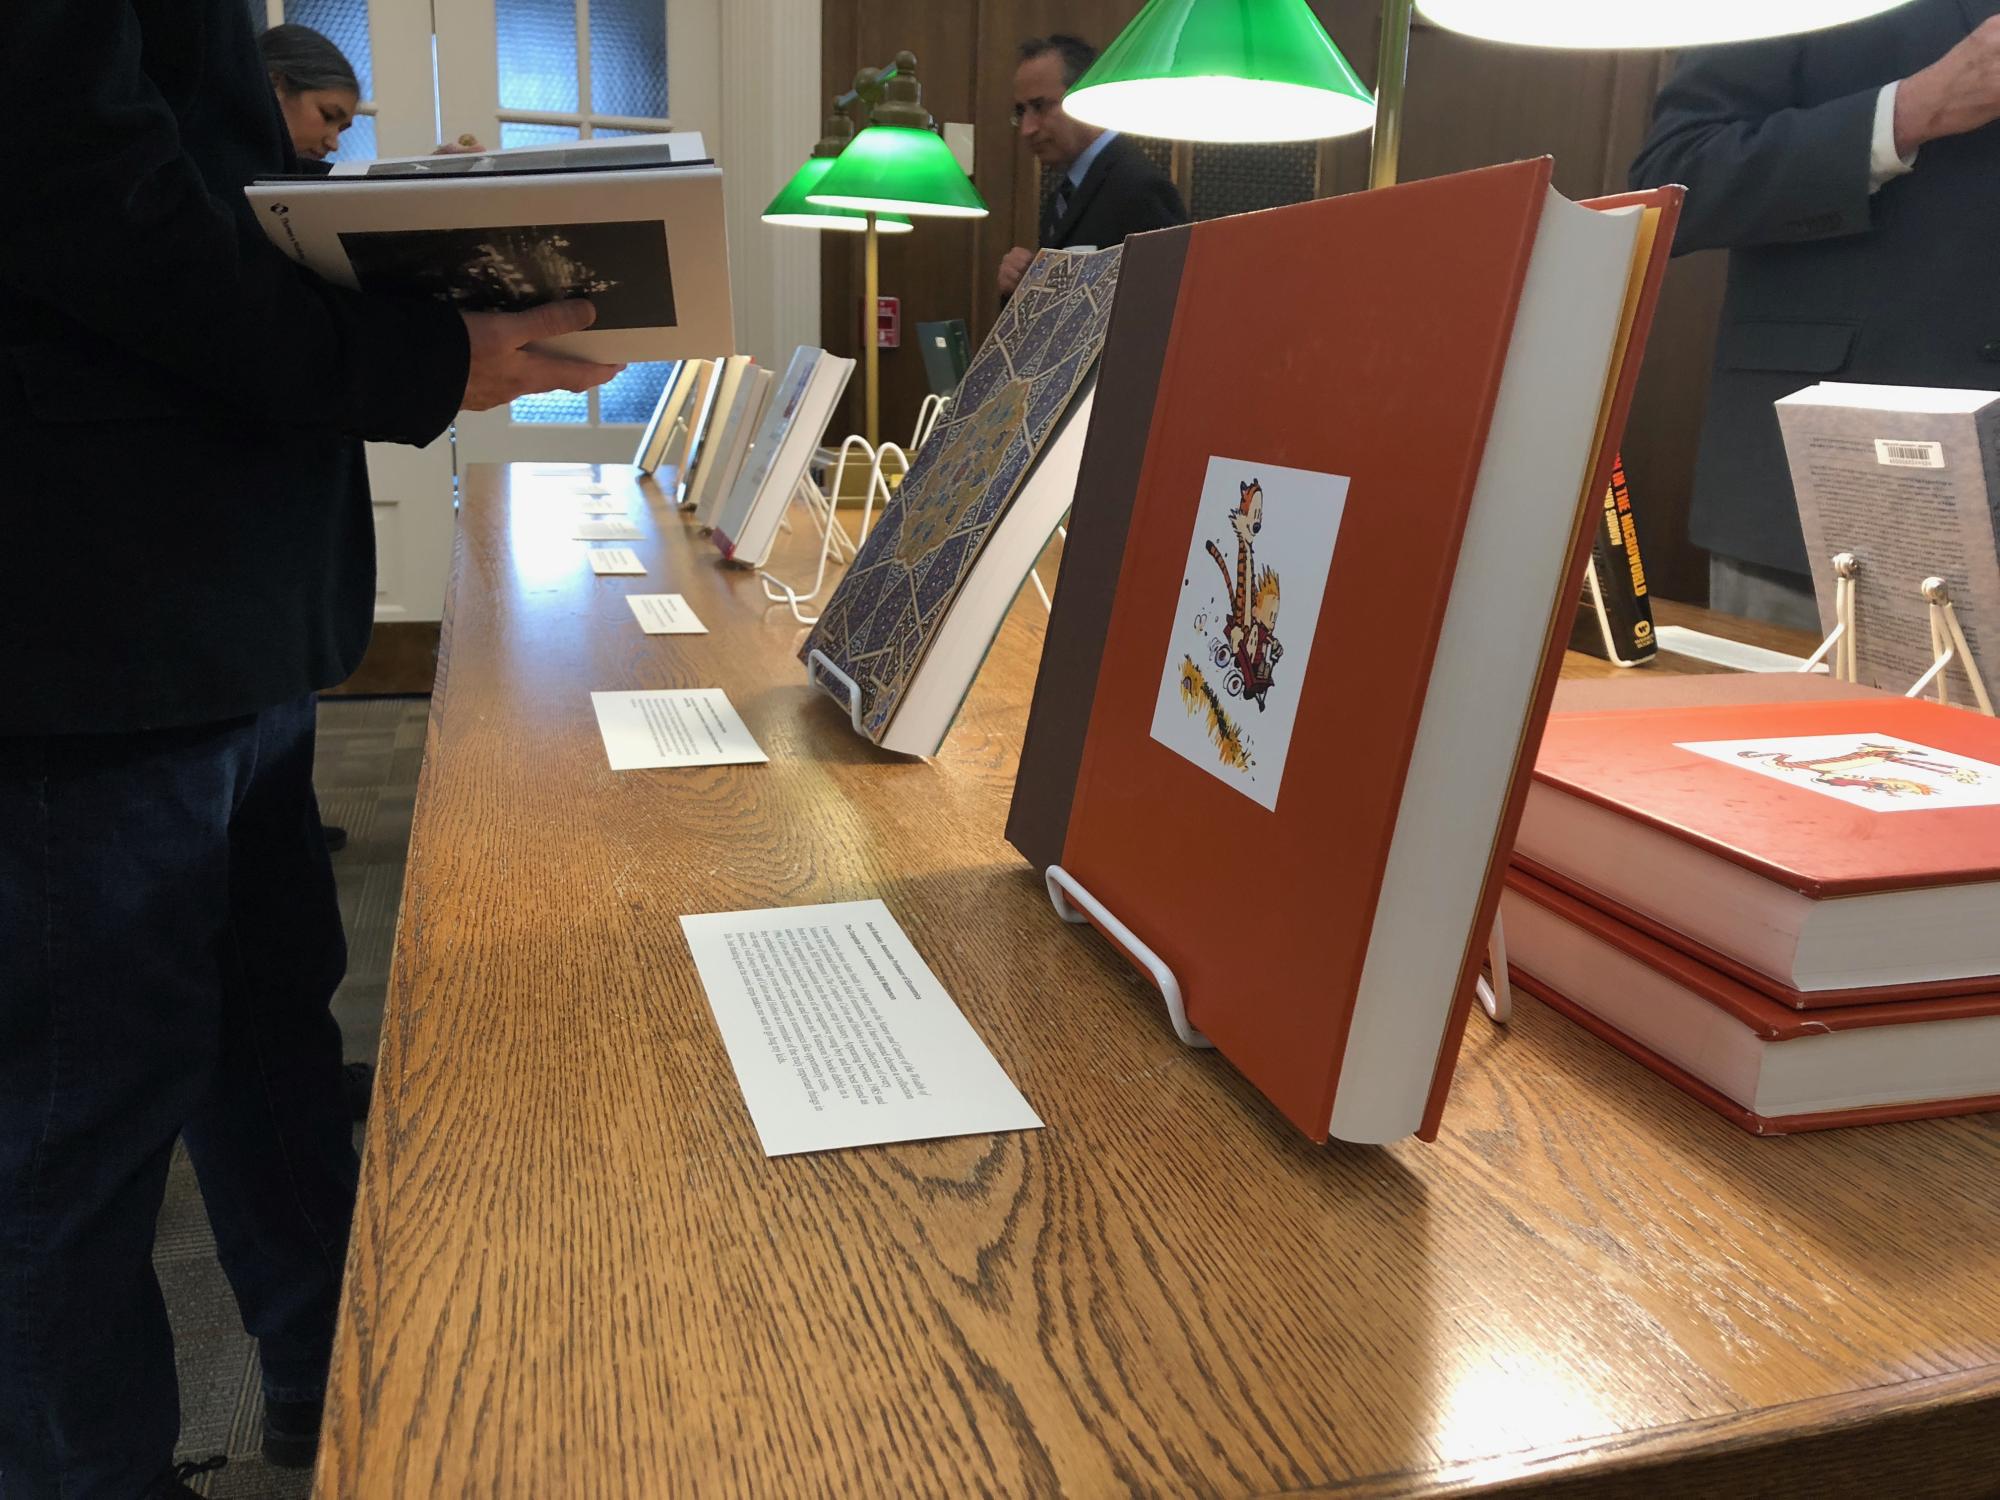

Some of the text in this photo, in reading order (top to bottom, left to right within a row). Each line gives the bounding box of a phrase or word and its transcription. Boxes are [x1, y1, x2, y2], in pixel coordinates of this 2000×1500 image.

[1616, 486, 1630, 514] THE
[1620, 512, 1647, 597] MICROWORLD
[880, 981, 897, 1000] Watterson
[832, 1048, 847, 1057] boy
[839, 1057, 852, 1066] and
[858, 1063, 876, 1082] between
[863, 1046, 883, 1068] collection
[877, 1075, 892, 1088] every
[847, 1073, 861, 1083] best
[908, 1073, 926, 1089] Wealth
